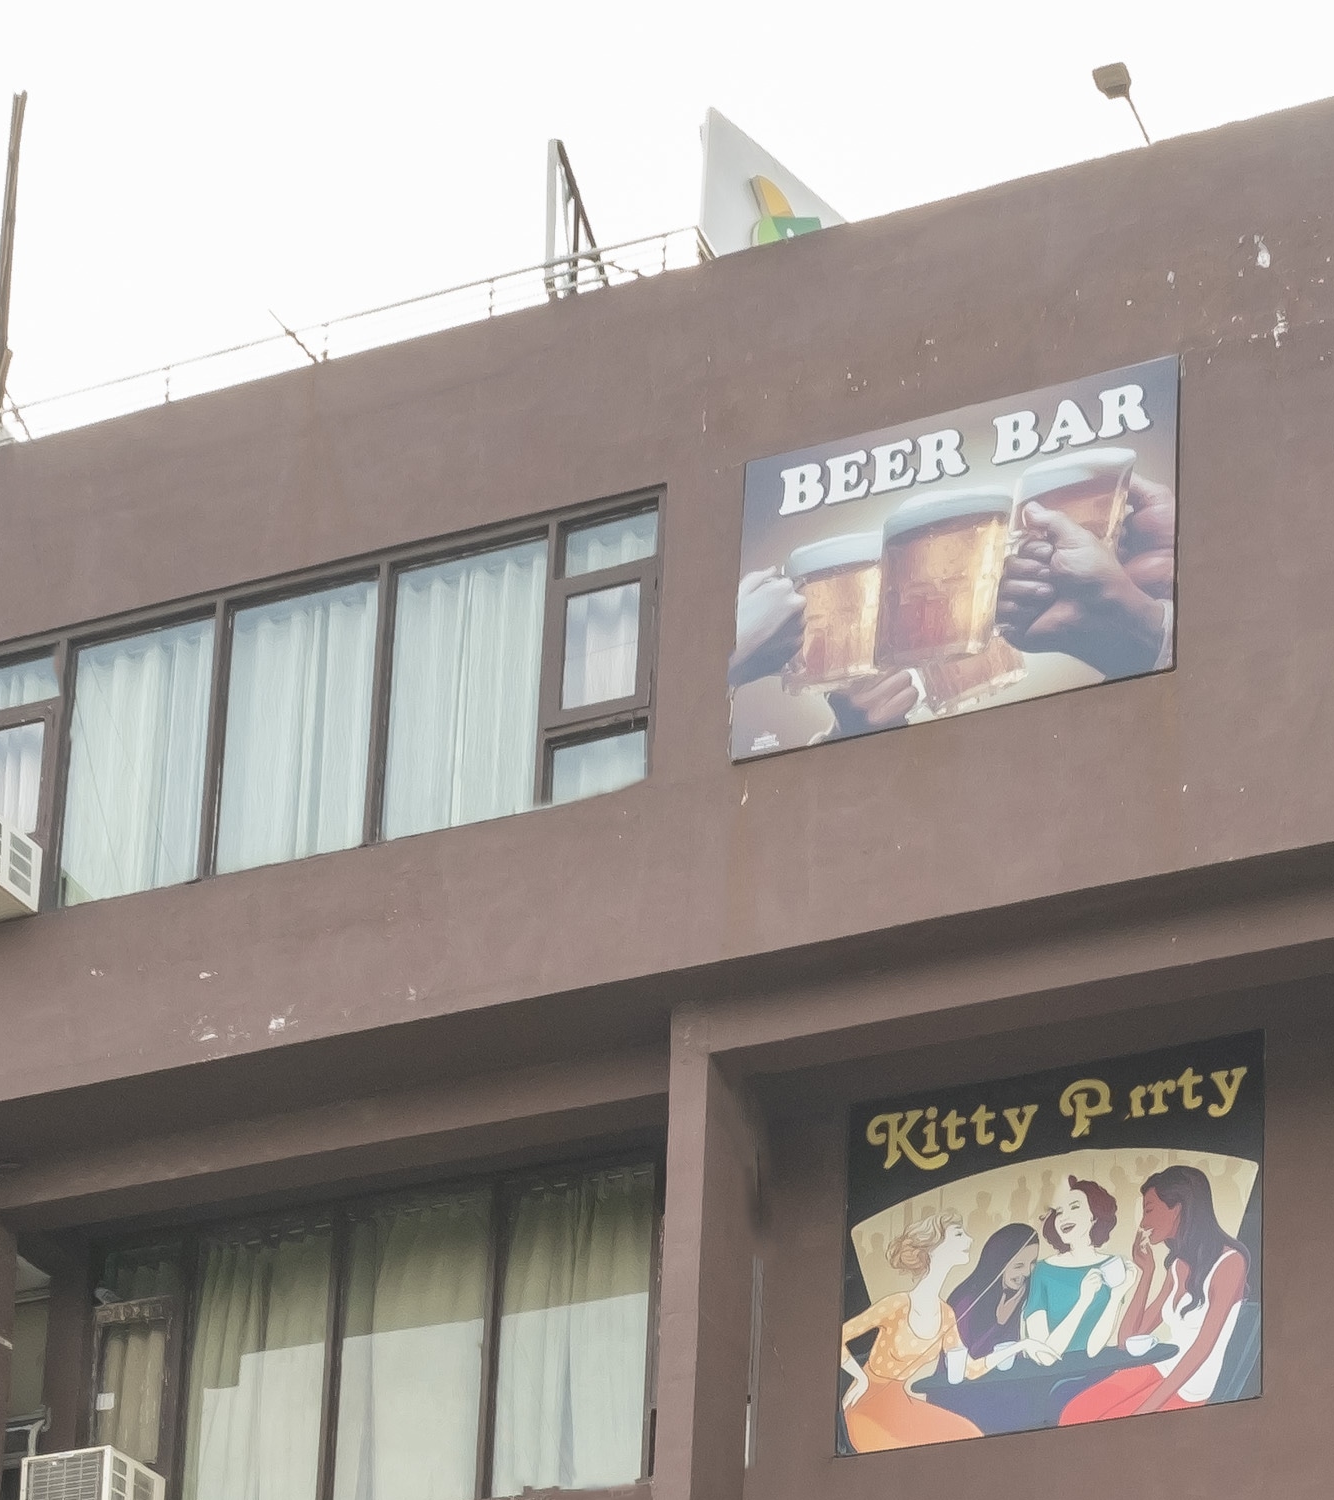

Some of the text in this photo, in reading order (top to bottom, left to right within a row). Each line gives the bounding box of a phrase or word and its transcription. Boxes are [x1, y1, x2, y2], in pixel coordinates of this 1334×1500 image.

[778, 384, 1151, 518] BEER BAR
[867, 1103, 1037, 1170] Kitty
